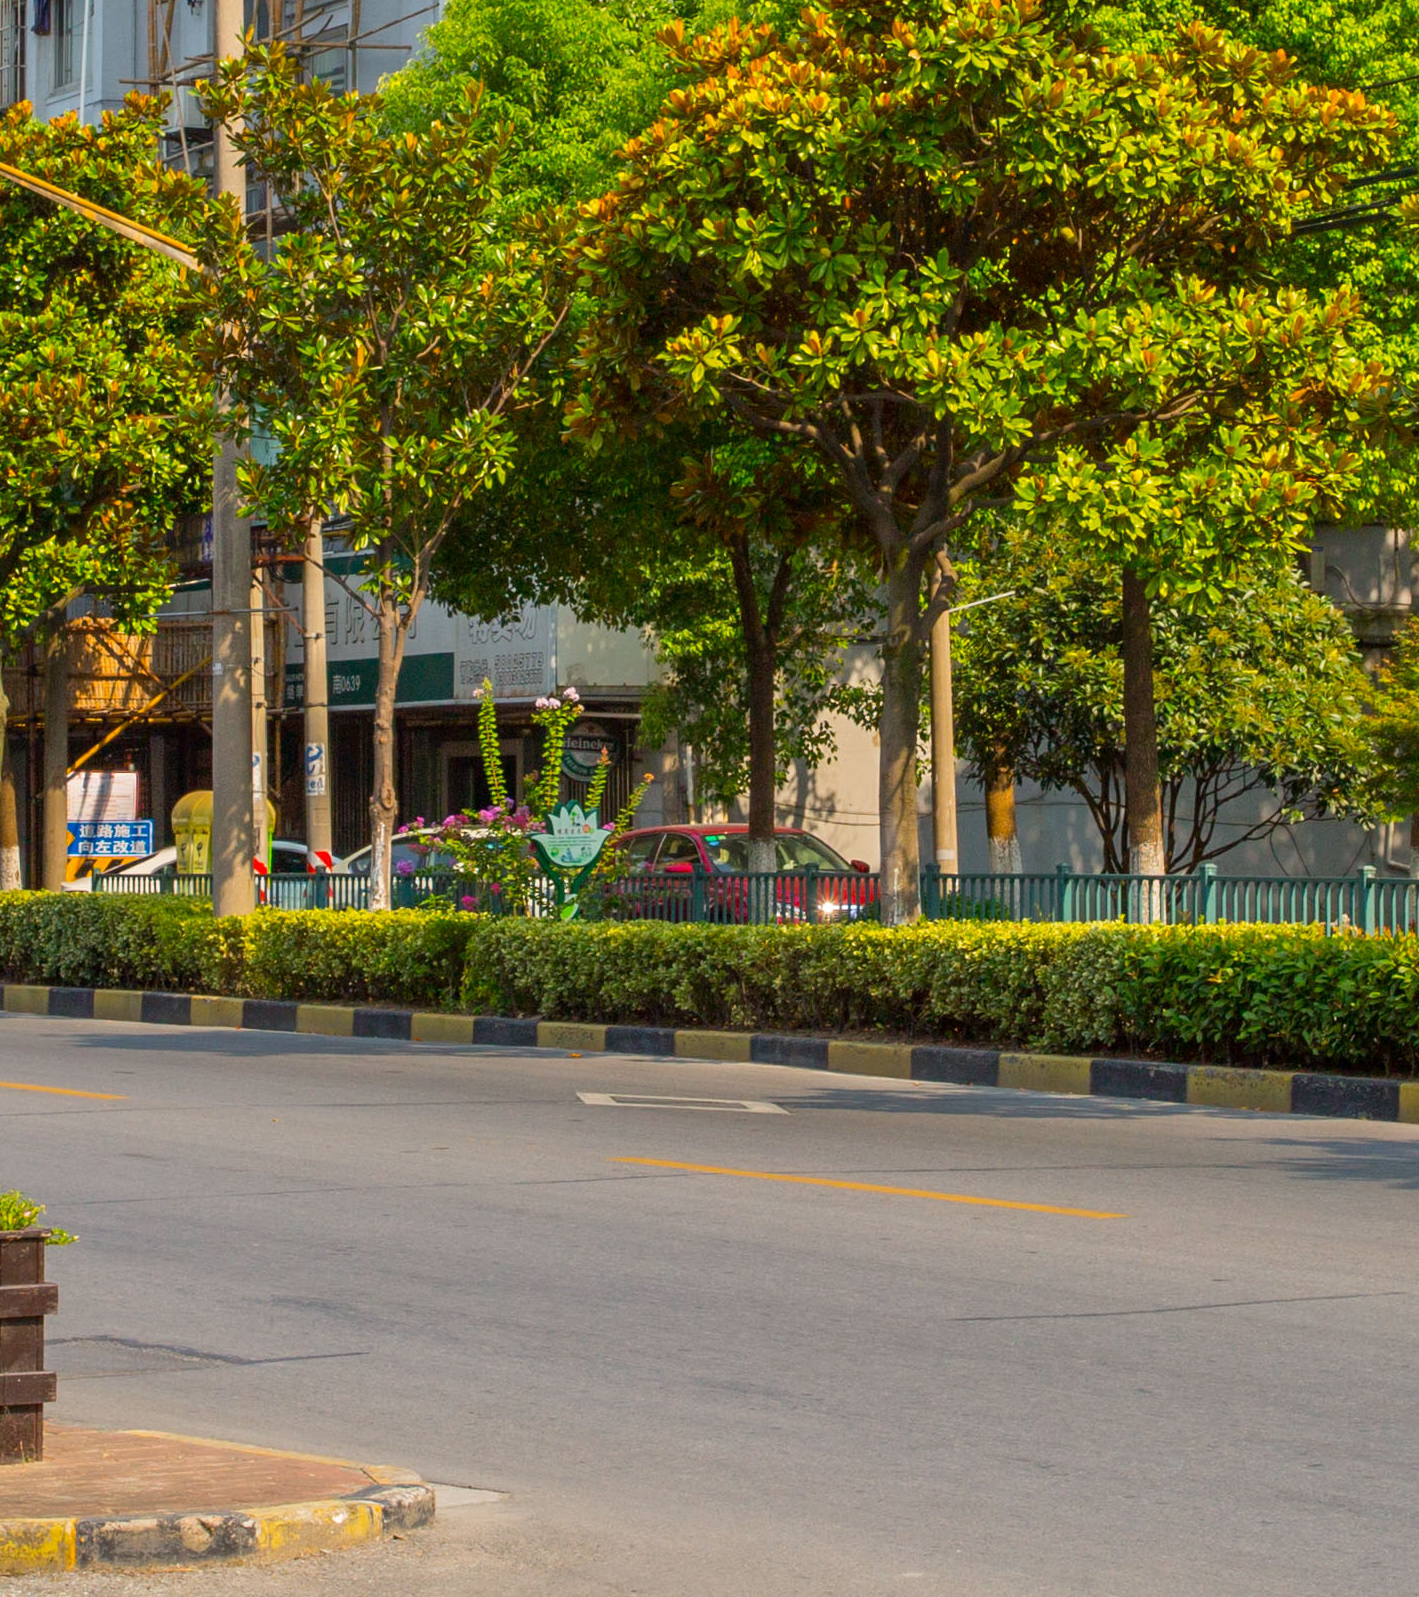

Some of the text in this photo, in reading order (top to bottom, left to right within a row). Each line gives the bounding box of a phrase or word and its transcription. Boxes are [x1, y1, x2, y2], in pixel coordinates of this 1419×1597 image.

[79, 824, 148, 838] 道路施工
[78, 840, 147, 854] 向左改道
